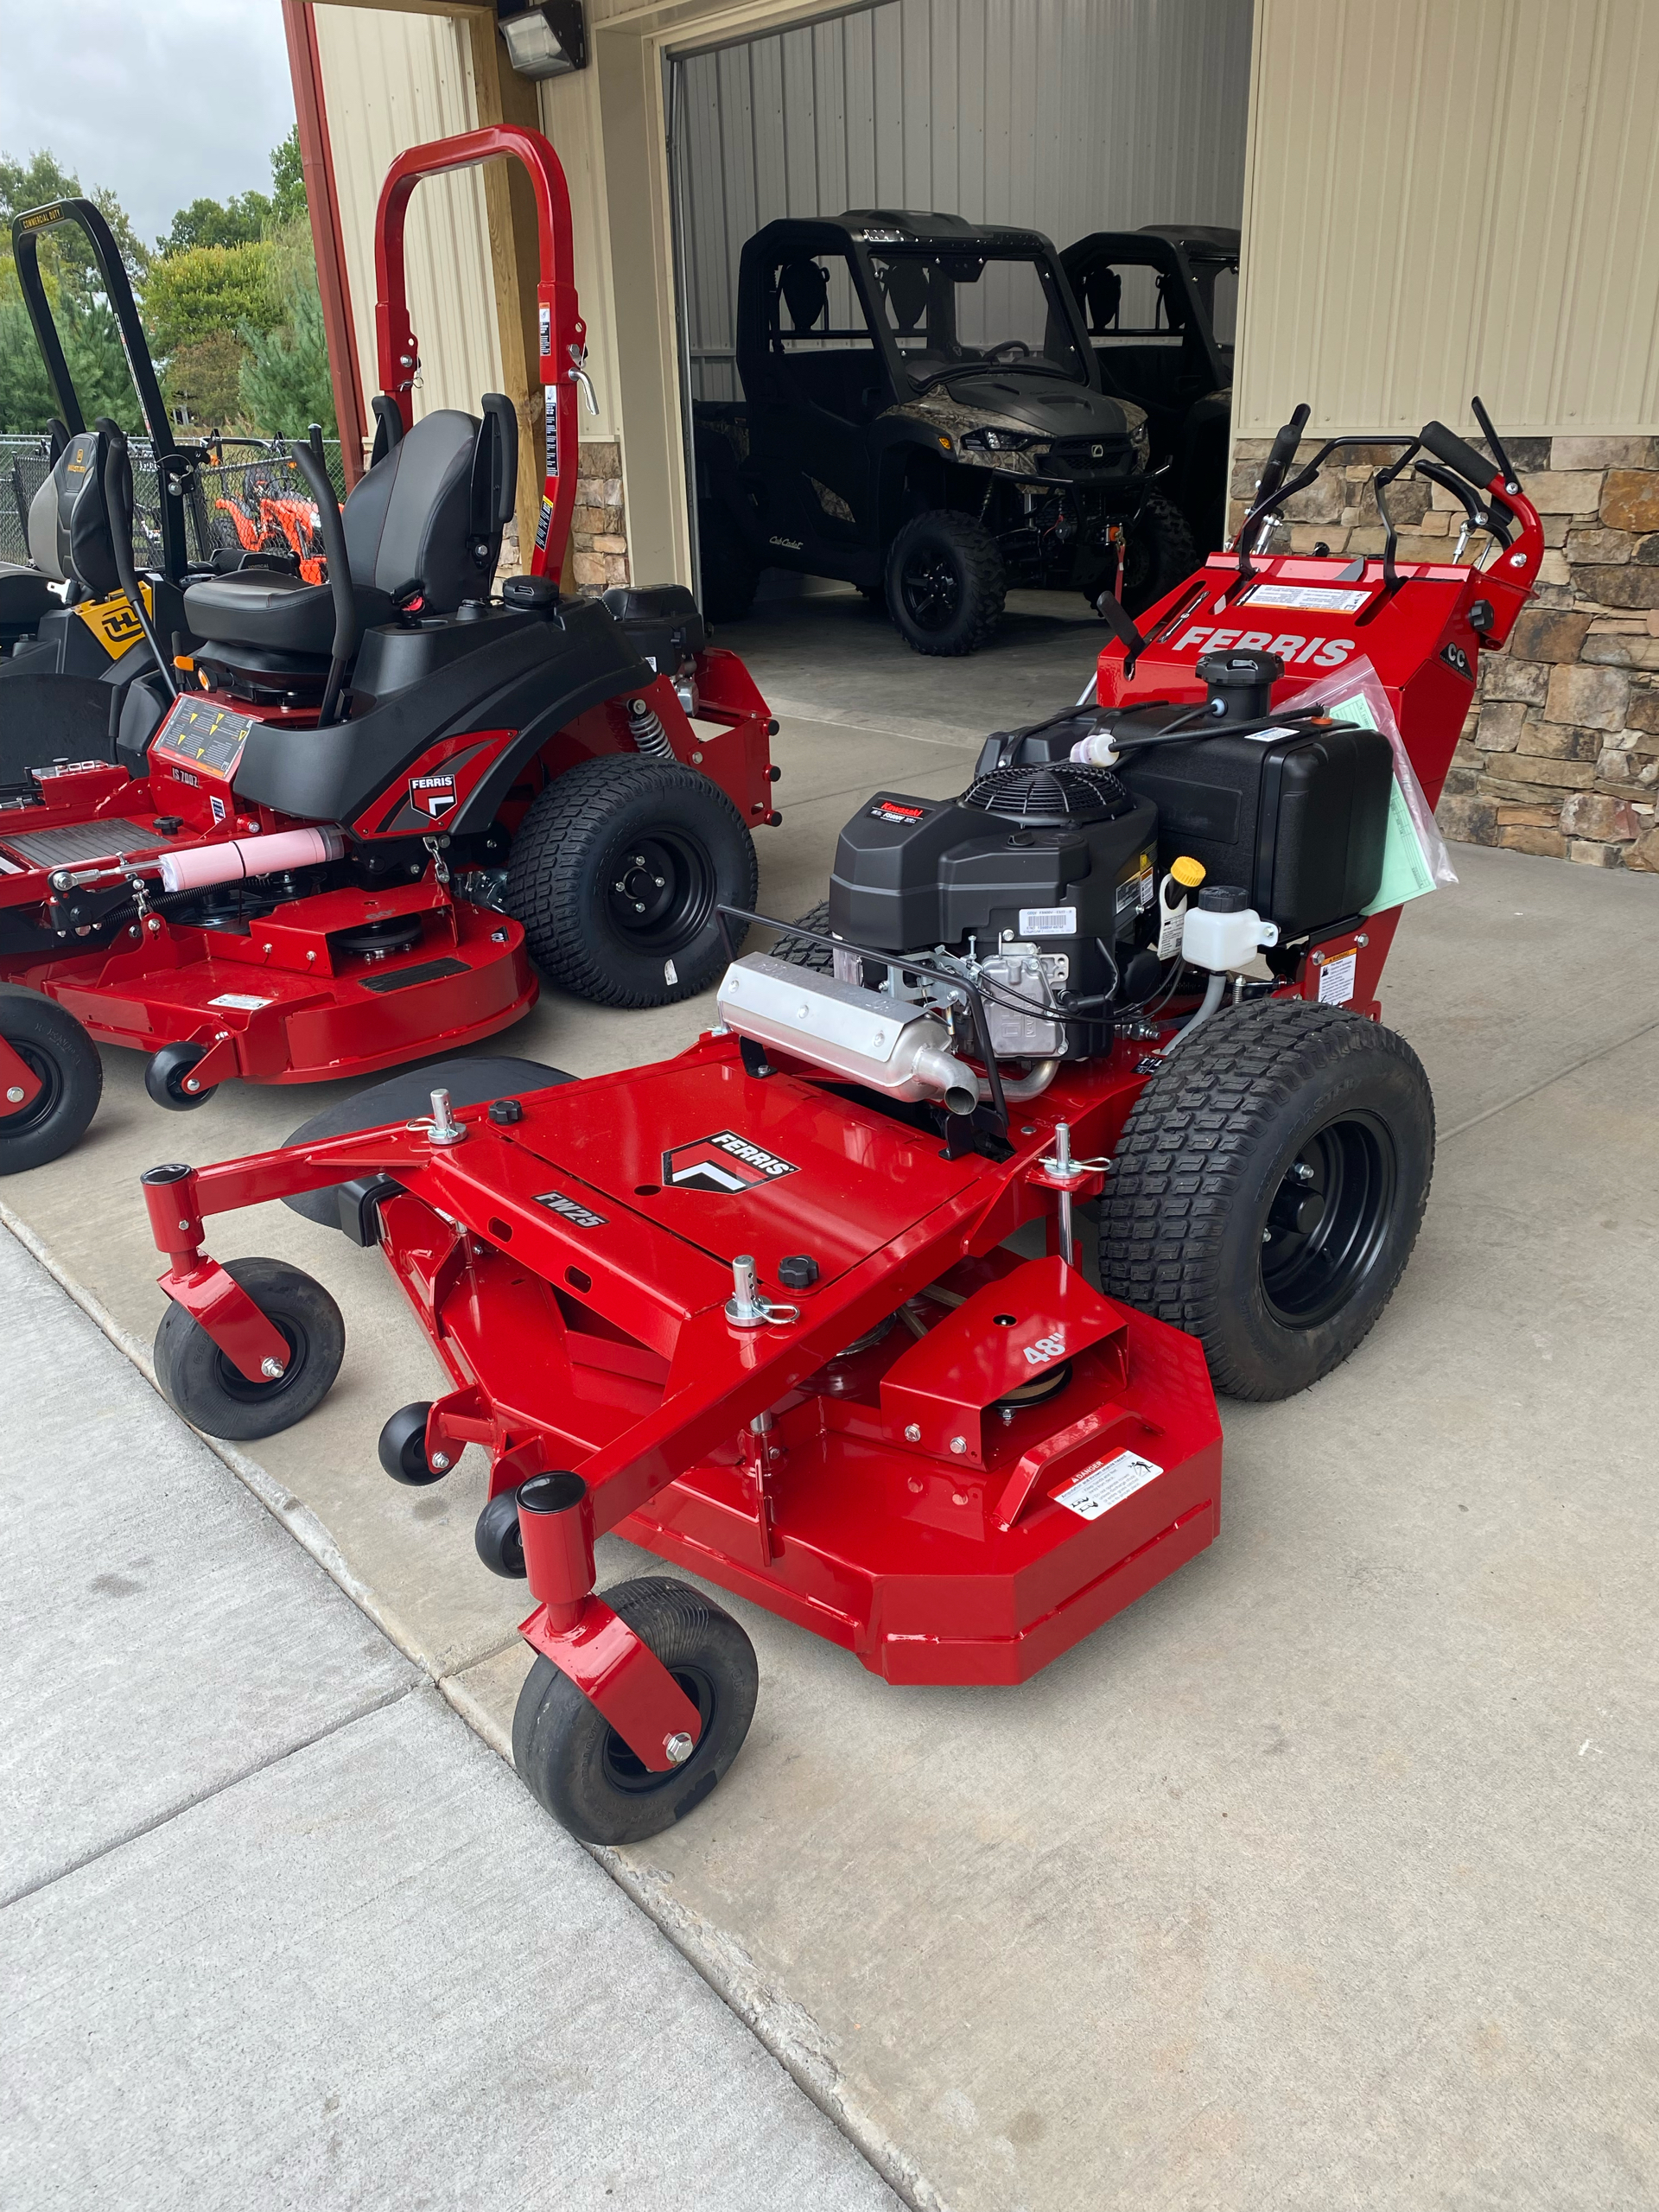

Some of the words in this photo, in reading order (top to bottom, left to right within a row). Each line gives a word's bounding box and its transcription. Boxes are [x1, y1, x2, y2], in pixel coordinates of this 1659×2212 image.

[22, 213, 49, 229] COMMERCIAL
[48, 208, 60, 220] DUTY
[769, 536, 783, 544] Cub
[781, 538, 804, 550] Cadet
[1172, 626, 1356, 666] FERRIS
[1448, 643, 1465, 667] CC
[412, 776, 453, 789] FERRIS
[880, 802, 924, 817] Kawasaki
[711, 1133, 790, 1175] FERRIS
[535, 1192, 606, 1227] FW25
[1023, 1332, 1065, 1364] 48"
[1077, 1460, 1104, 1480] DANGER
